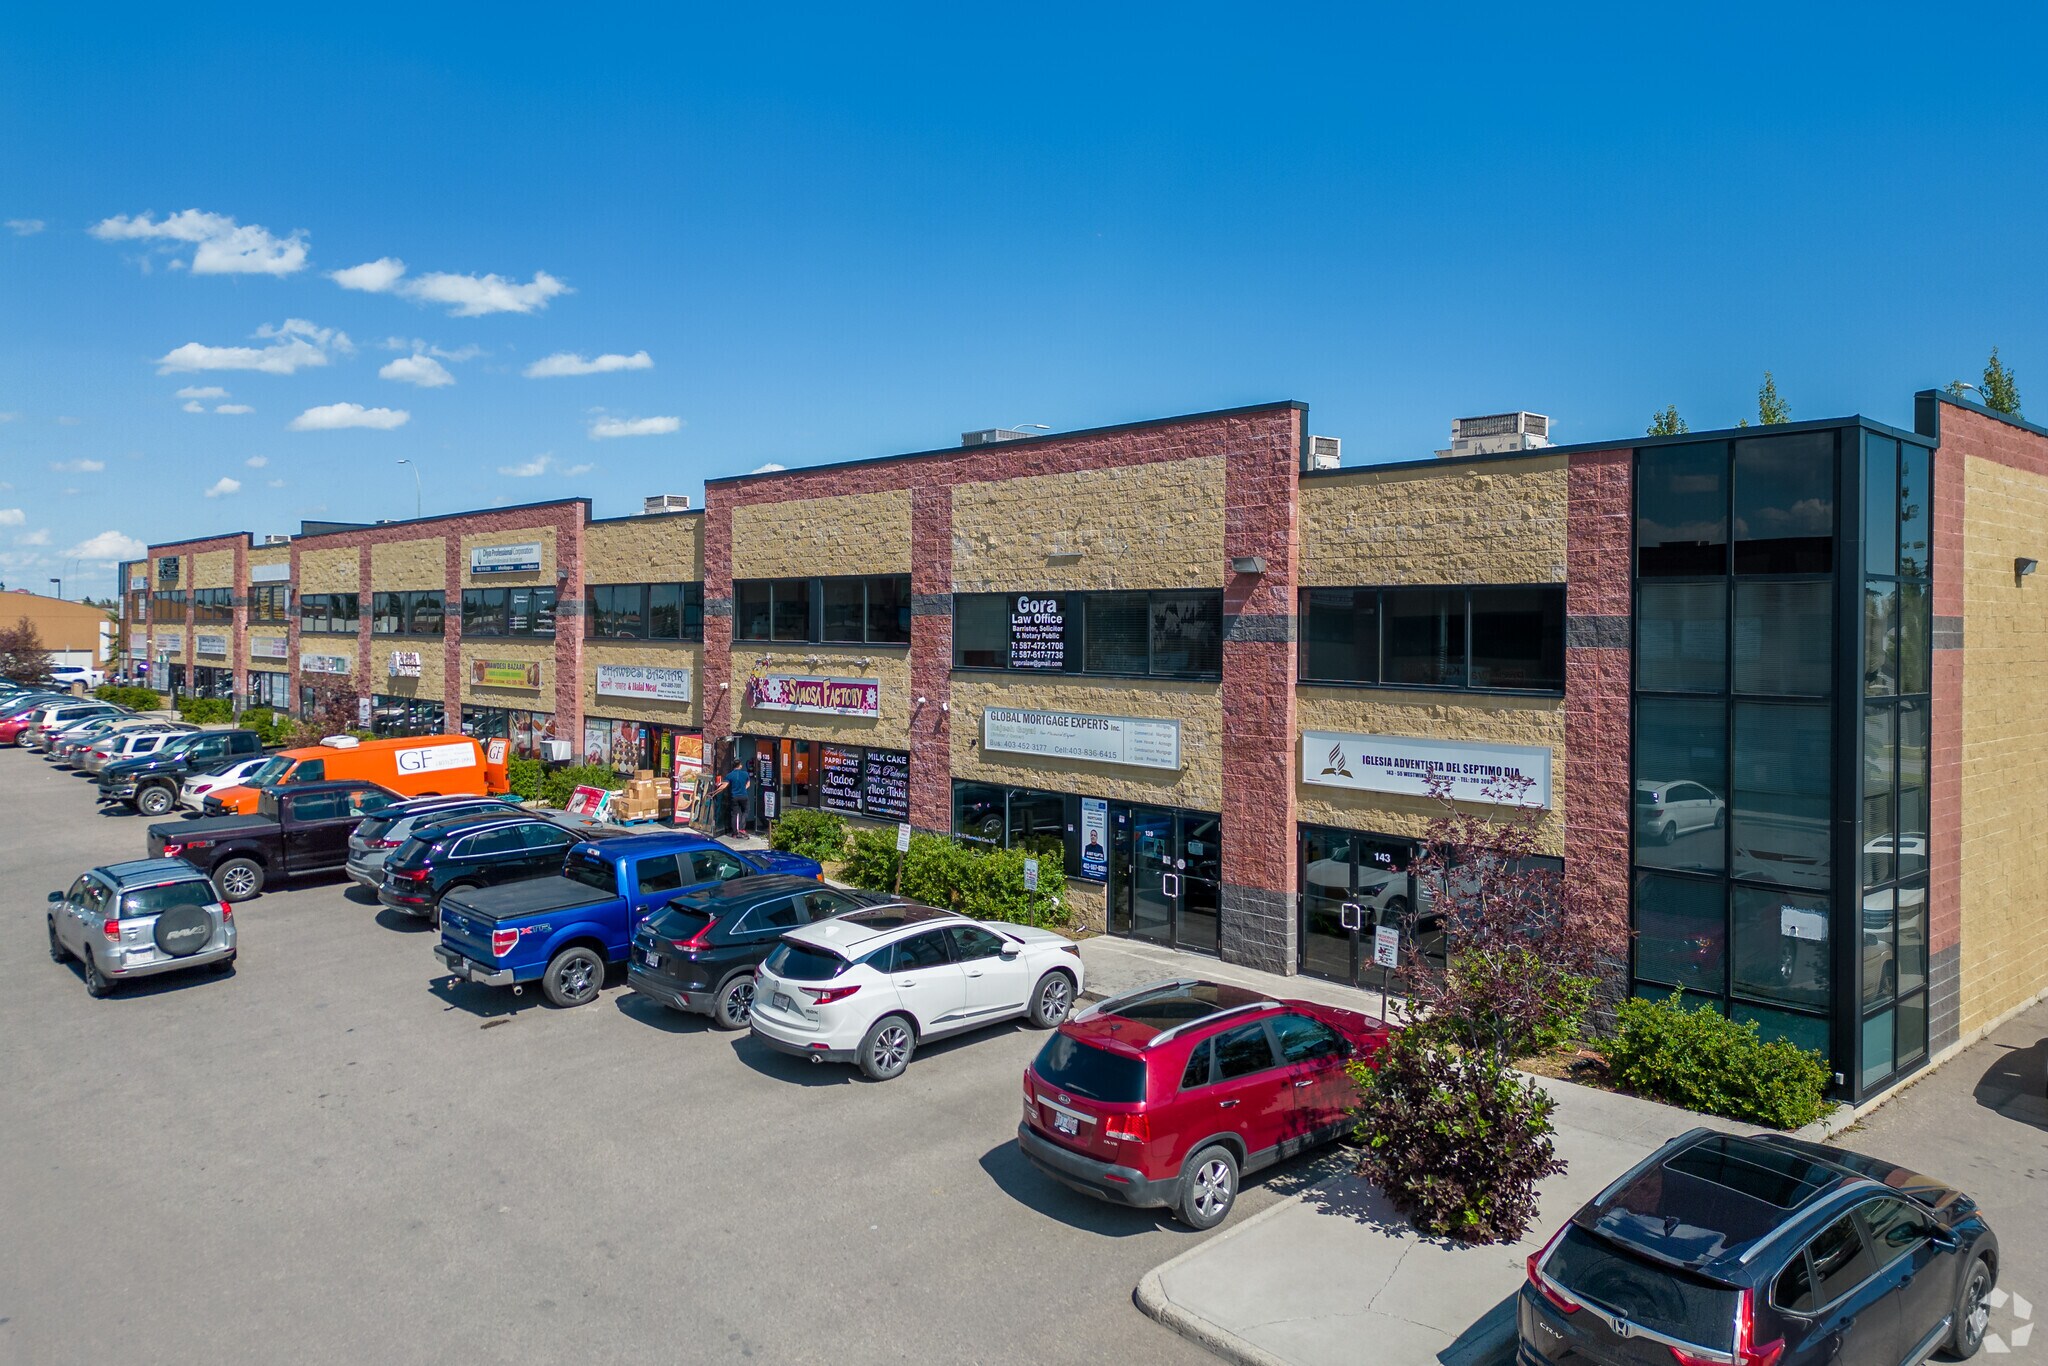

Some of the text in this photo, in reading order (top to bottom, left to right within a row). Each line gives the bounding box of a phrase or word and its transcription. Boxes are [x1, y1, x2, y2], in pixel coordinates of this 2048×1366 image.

[1017, 596, 1057, 613] Gora
[1012, 613, 1062, 623] Law Office
[1019, 642, 1064, 650] 587-472-1708
[1019, 651, 1063, 659] 587-617-7738
[646, 668, 684, 682] BAZAAR
[632, 682, 644, 692] Halal
[645, 683, 657, 692] Meat
[991, 711, 1020, 723] GLOBAL
[1023, 713, 1069, 727] MORTGAGE
[1071, 717, 1109, 730] EXPERTS
[489, 745, 503, 760] GF
[399, 750, 433, 771] GF
[842, 758, 858, 766] CHAT
[868, 753, 907, 764] MILK CAKE
[1362, 755, 1520, 777] IGLESIA ADVENTISTA DEL SEPTIMO DIA
[868, 776, 906, 787] MINT CHUTNEY
[887, 787, 906, 798] Tikki
[867, 796, 907, 807] GULAB JAMUN
[1374, 852, 1391, 862] 143
[166, 925, 206, 940] RAV4
[520, 923, 552, 935] XTR
[1540, 1322, 1564, 1339] CR-V
